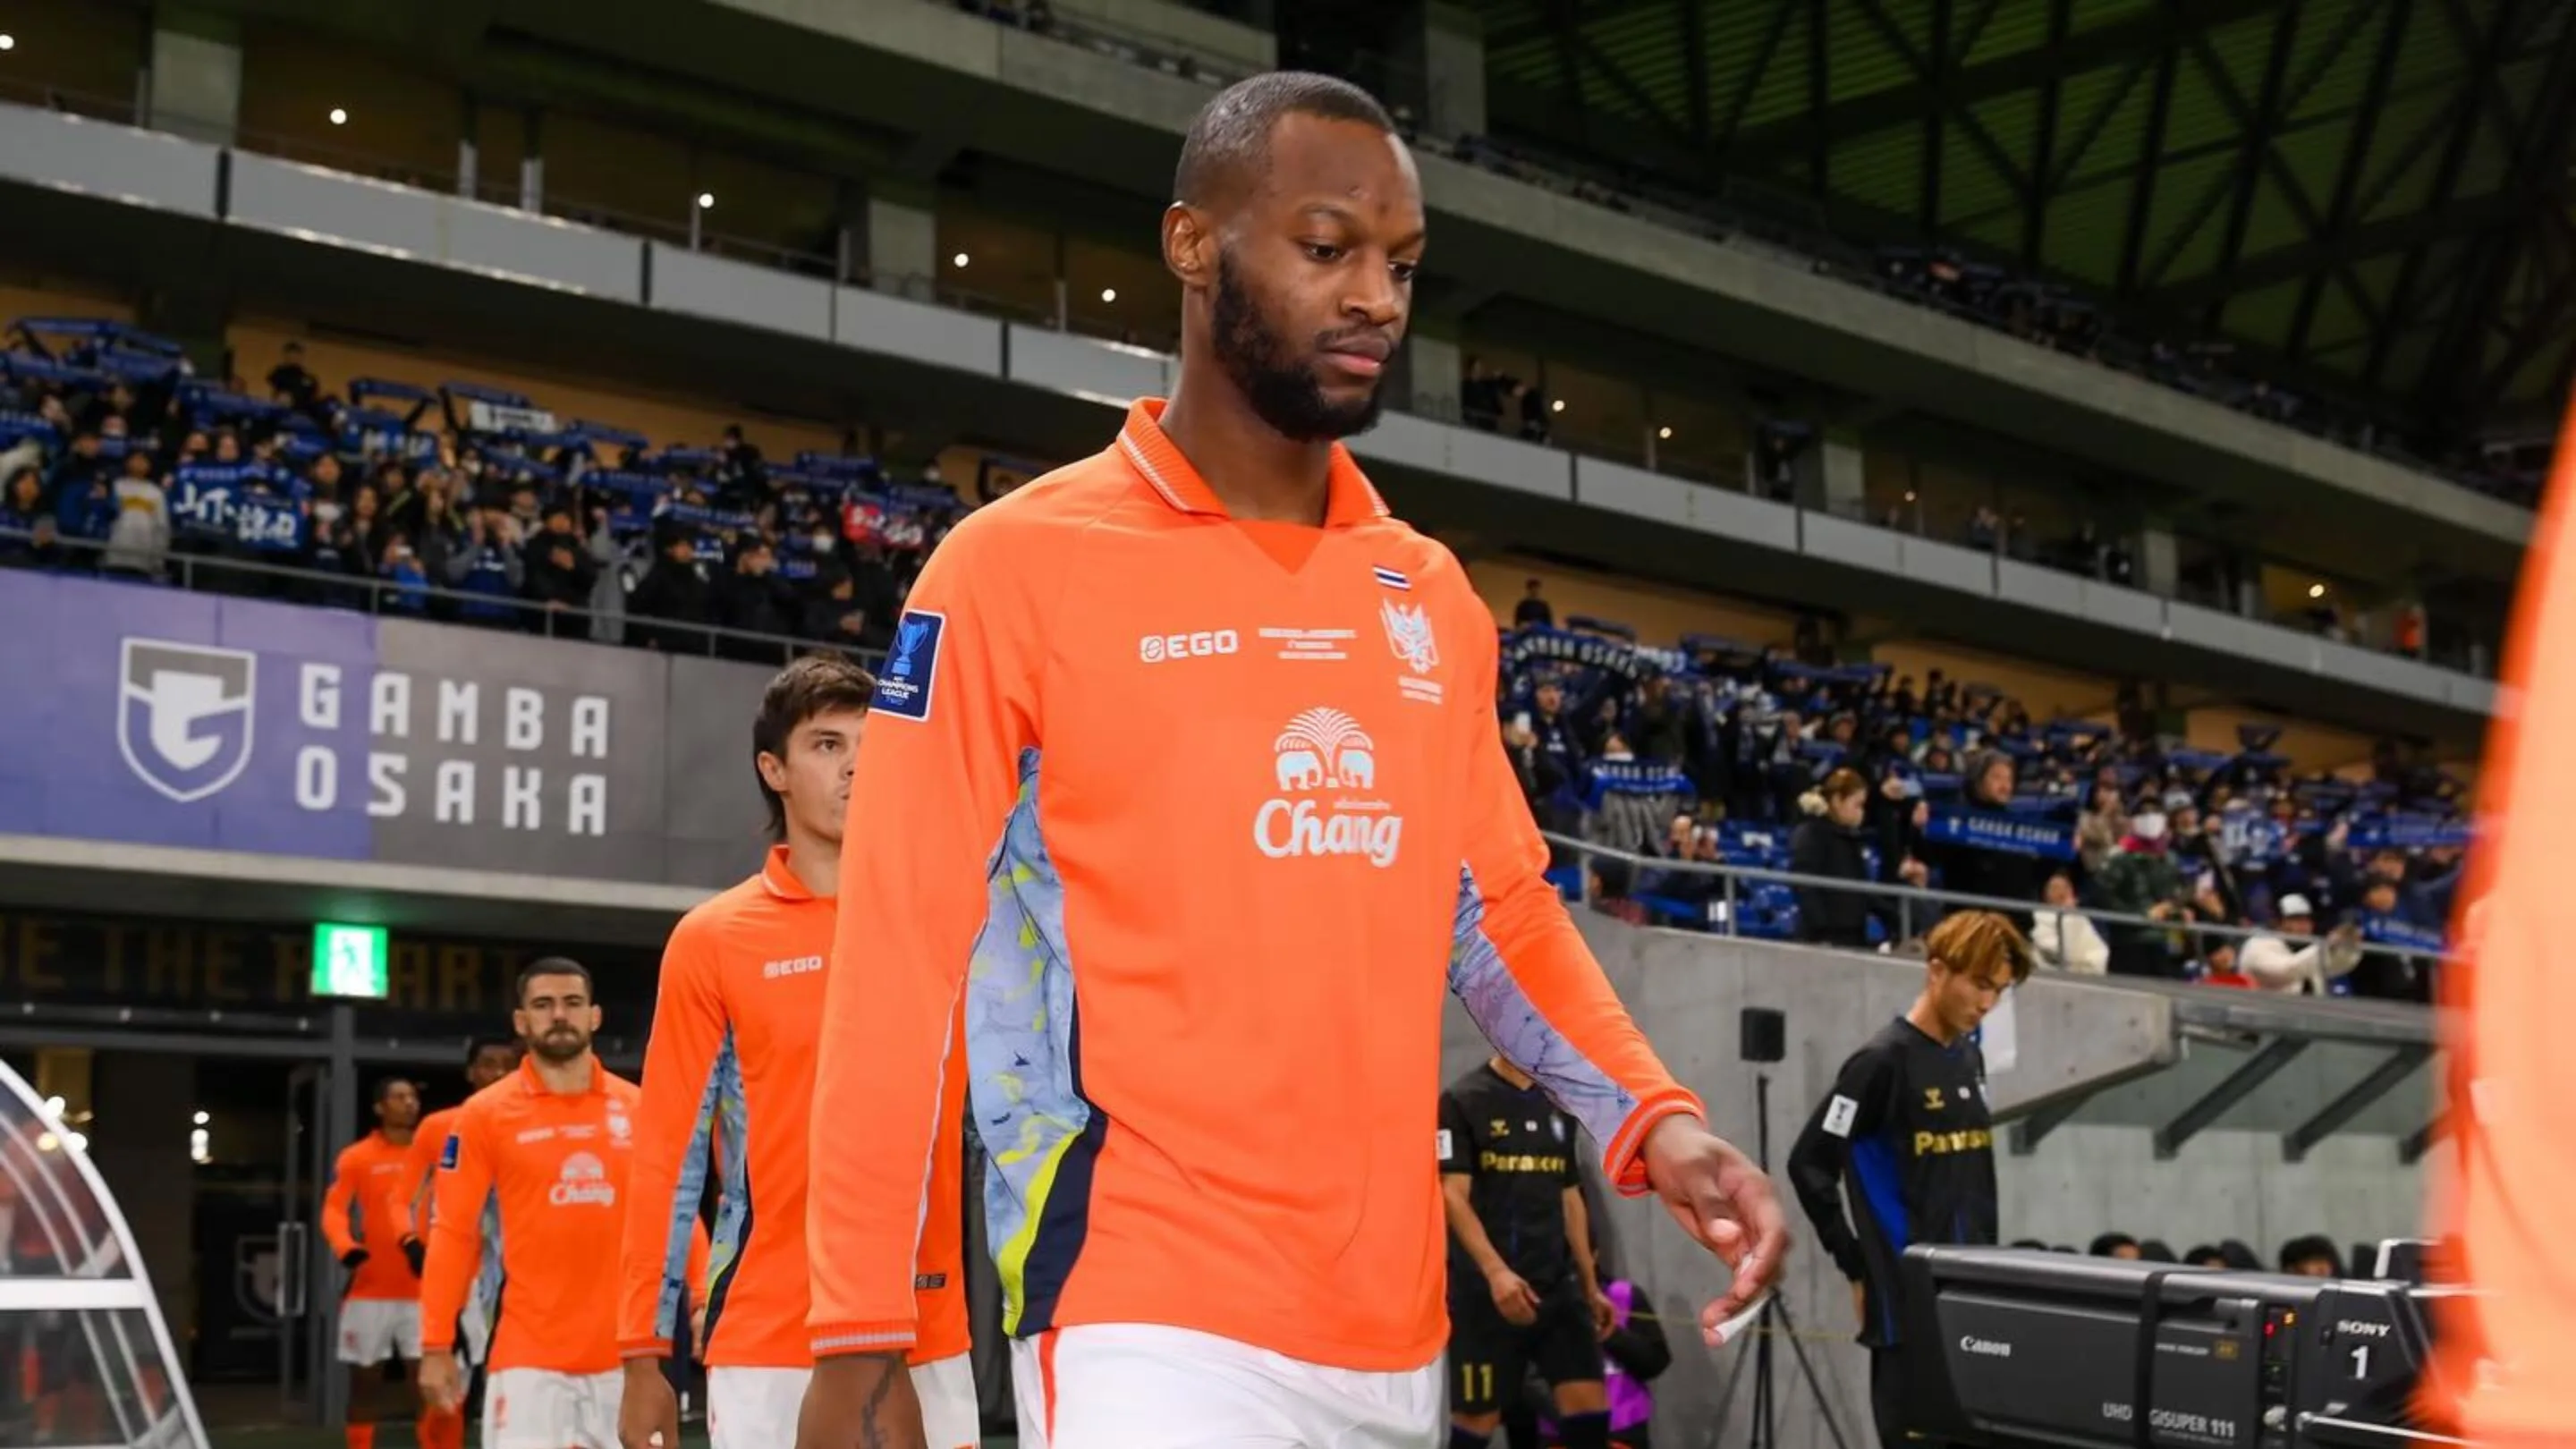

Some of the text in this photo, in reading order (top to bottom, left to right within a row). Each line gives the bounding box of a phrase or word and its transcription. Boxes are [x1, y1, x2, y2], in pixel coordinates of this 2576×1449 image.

[1166, 630, 1238, 658] EGO
[1580, 641, 1638, 679] OSAKA
[300, 662, 609, 758] GAMBA
[295, 745, 606, 835] OSAKA
[1254, 798, 1402, 868] Chang
[549, 1182, 614, 1208] Chang
[1961, 1335, 2011, 1357] Canon
[2337, 1319, 2390, 1337] SONY
[2351, 1344, 2368, 1380] 1
[1462, 1363, 1492, 1402] 11
[2103, 1402, 2132, 1420] UHD
[2148, 1409, 2207, 1432] GISUPER
[2210, 1418, 2235, 1438] 111
